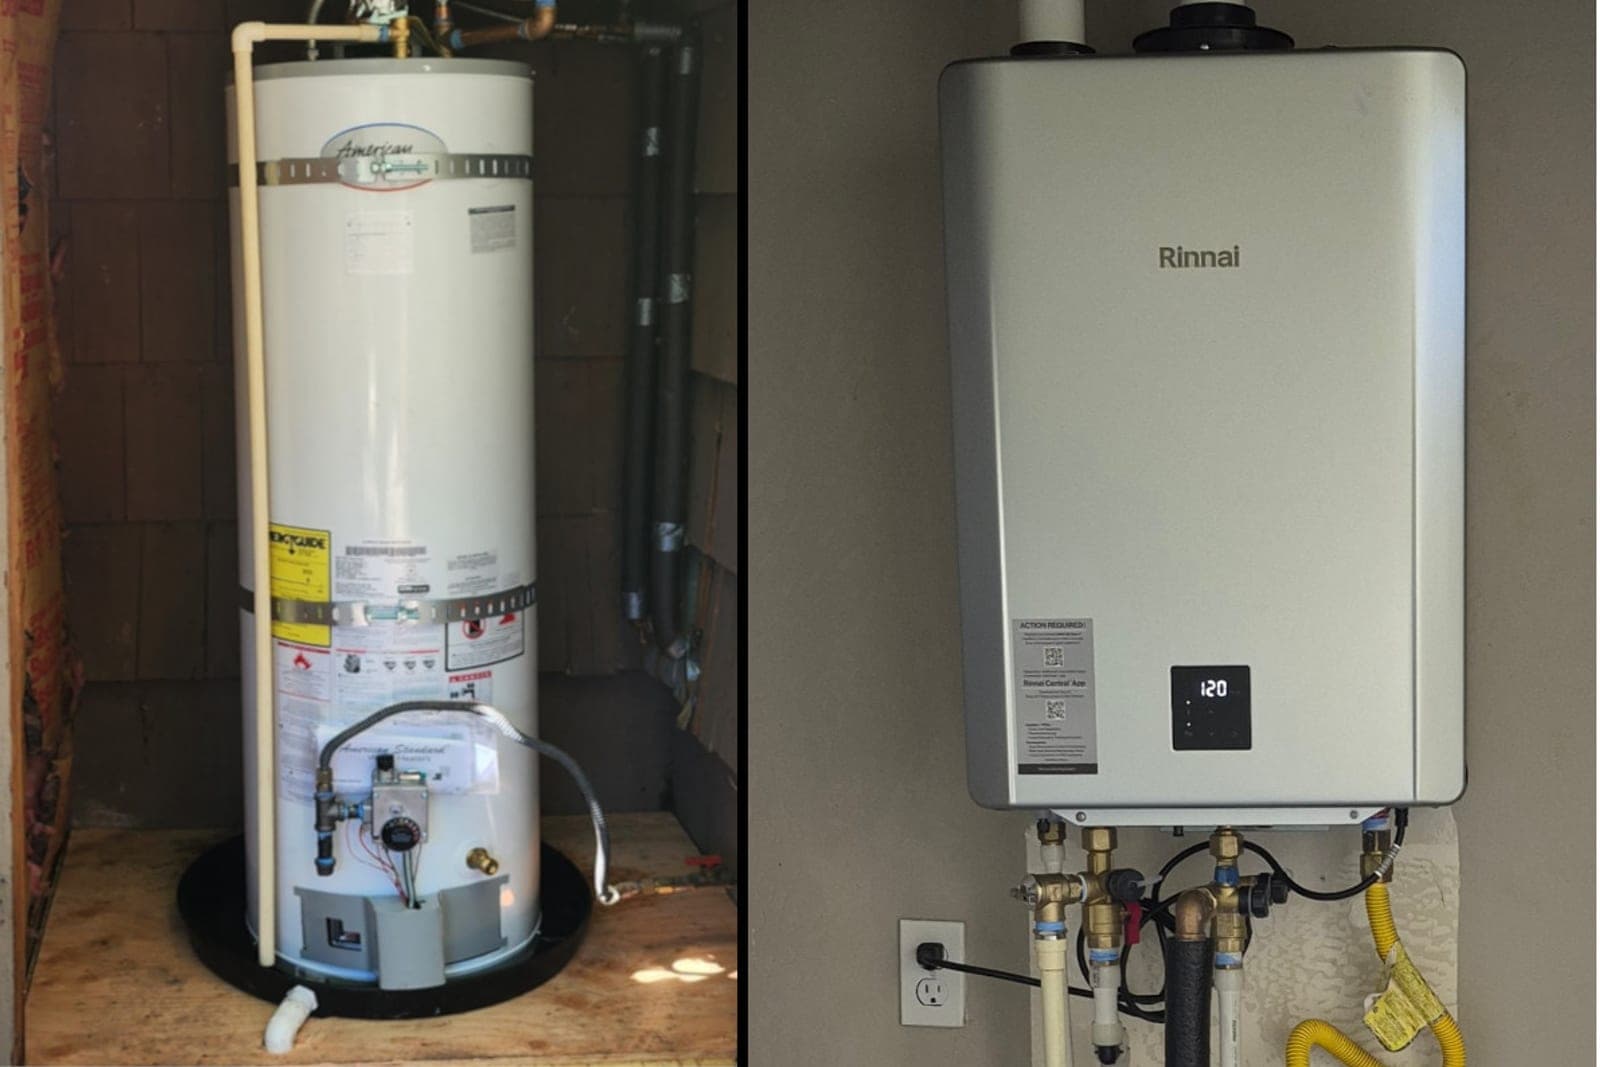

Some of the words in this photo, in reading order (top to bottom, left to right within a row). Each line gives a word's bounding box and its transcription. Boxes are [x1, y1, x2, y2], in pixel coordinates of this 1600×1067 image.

[336, 140, 413, 158] American
[1159, 244, 1240, 268] Rinnai
[1201, 680, 1227, 697] 120
